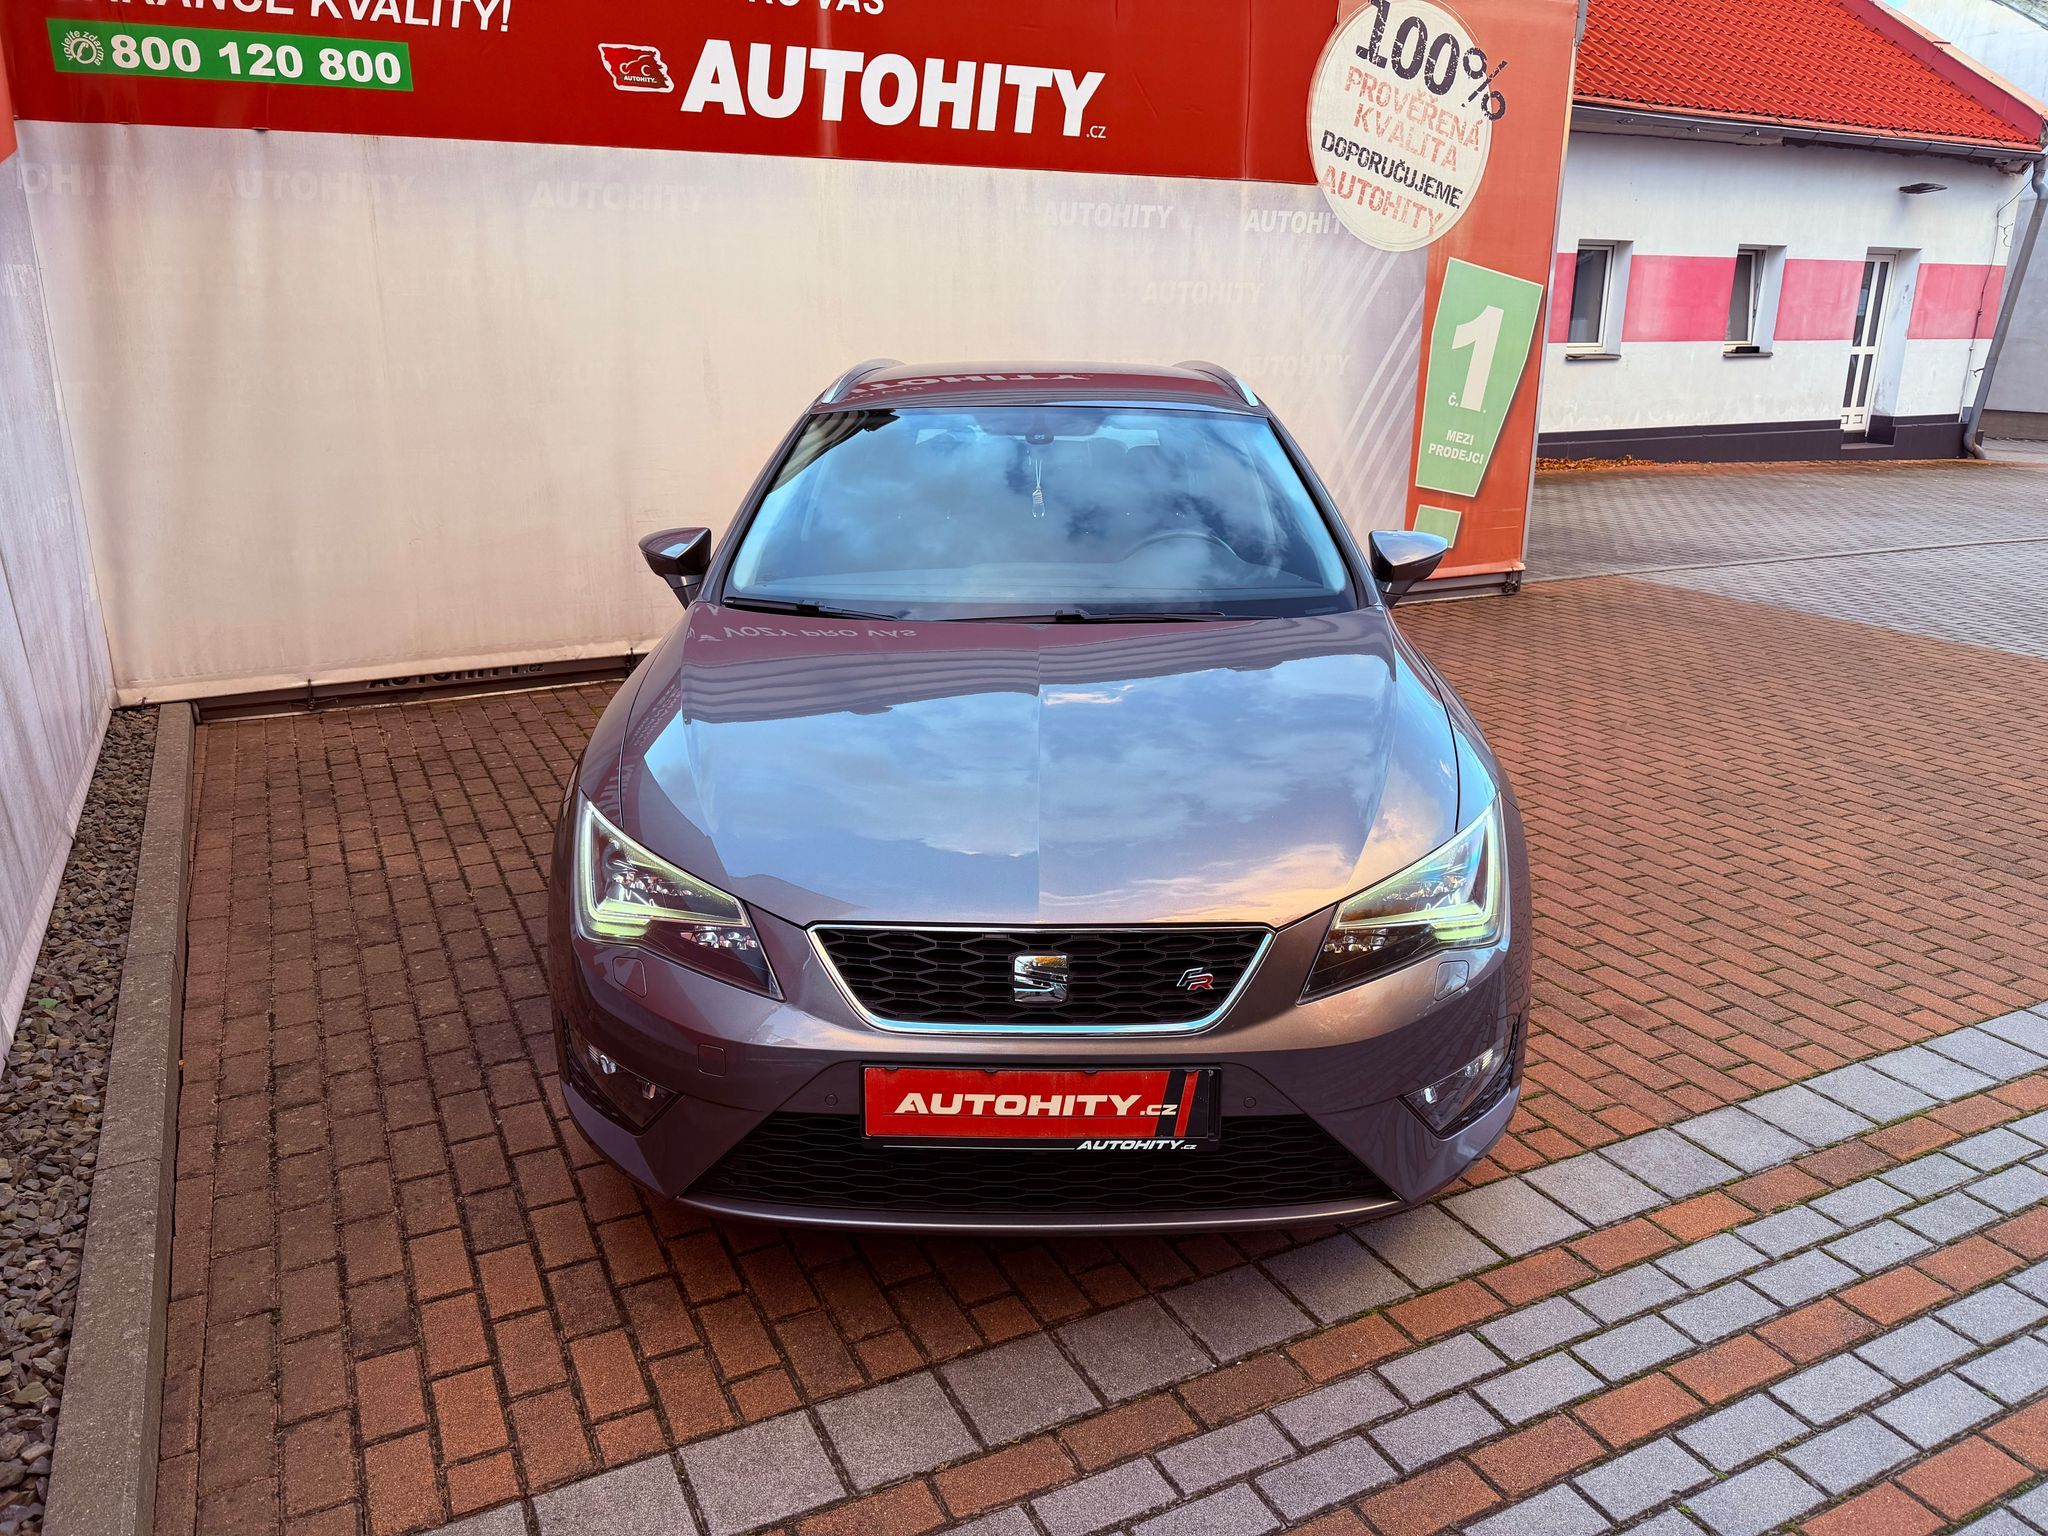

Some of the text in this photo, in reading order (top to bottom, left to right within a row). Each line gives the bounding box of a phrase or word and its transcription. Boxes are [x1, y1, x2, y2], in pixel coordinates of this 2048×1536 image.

[110, 34, 402, 84] 800 120 800
[1355, 0, 1508, 121] 100%
[1344, 66, 1483, 151] PROVĚŘENÁ
[1353, 103, 1458, 172] KVALITA
[1320, 130, 1464, 209] DOPORUČUJEME
[1319, 165, 1444, 236] AUTOHITY
[1243, 208, 1352, 235] AUTOHIT
[1428, 443, 1485, 465] PRODEJCI
[1446, 429, 1474, 446] MEZI
[1176, 967, 1215, 991] FR
[894, 1092, 1178, 1117] AUTOHITY.cz
[1076, 1139, 1198, 1151] AUTOHITY.cz
